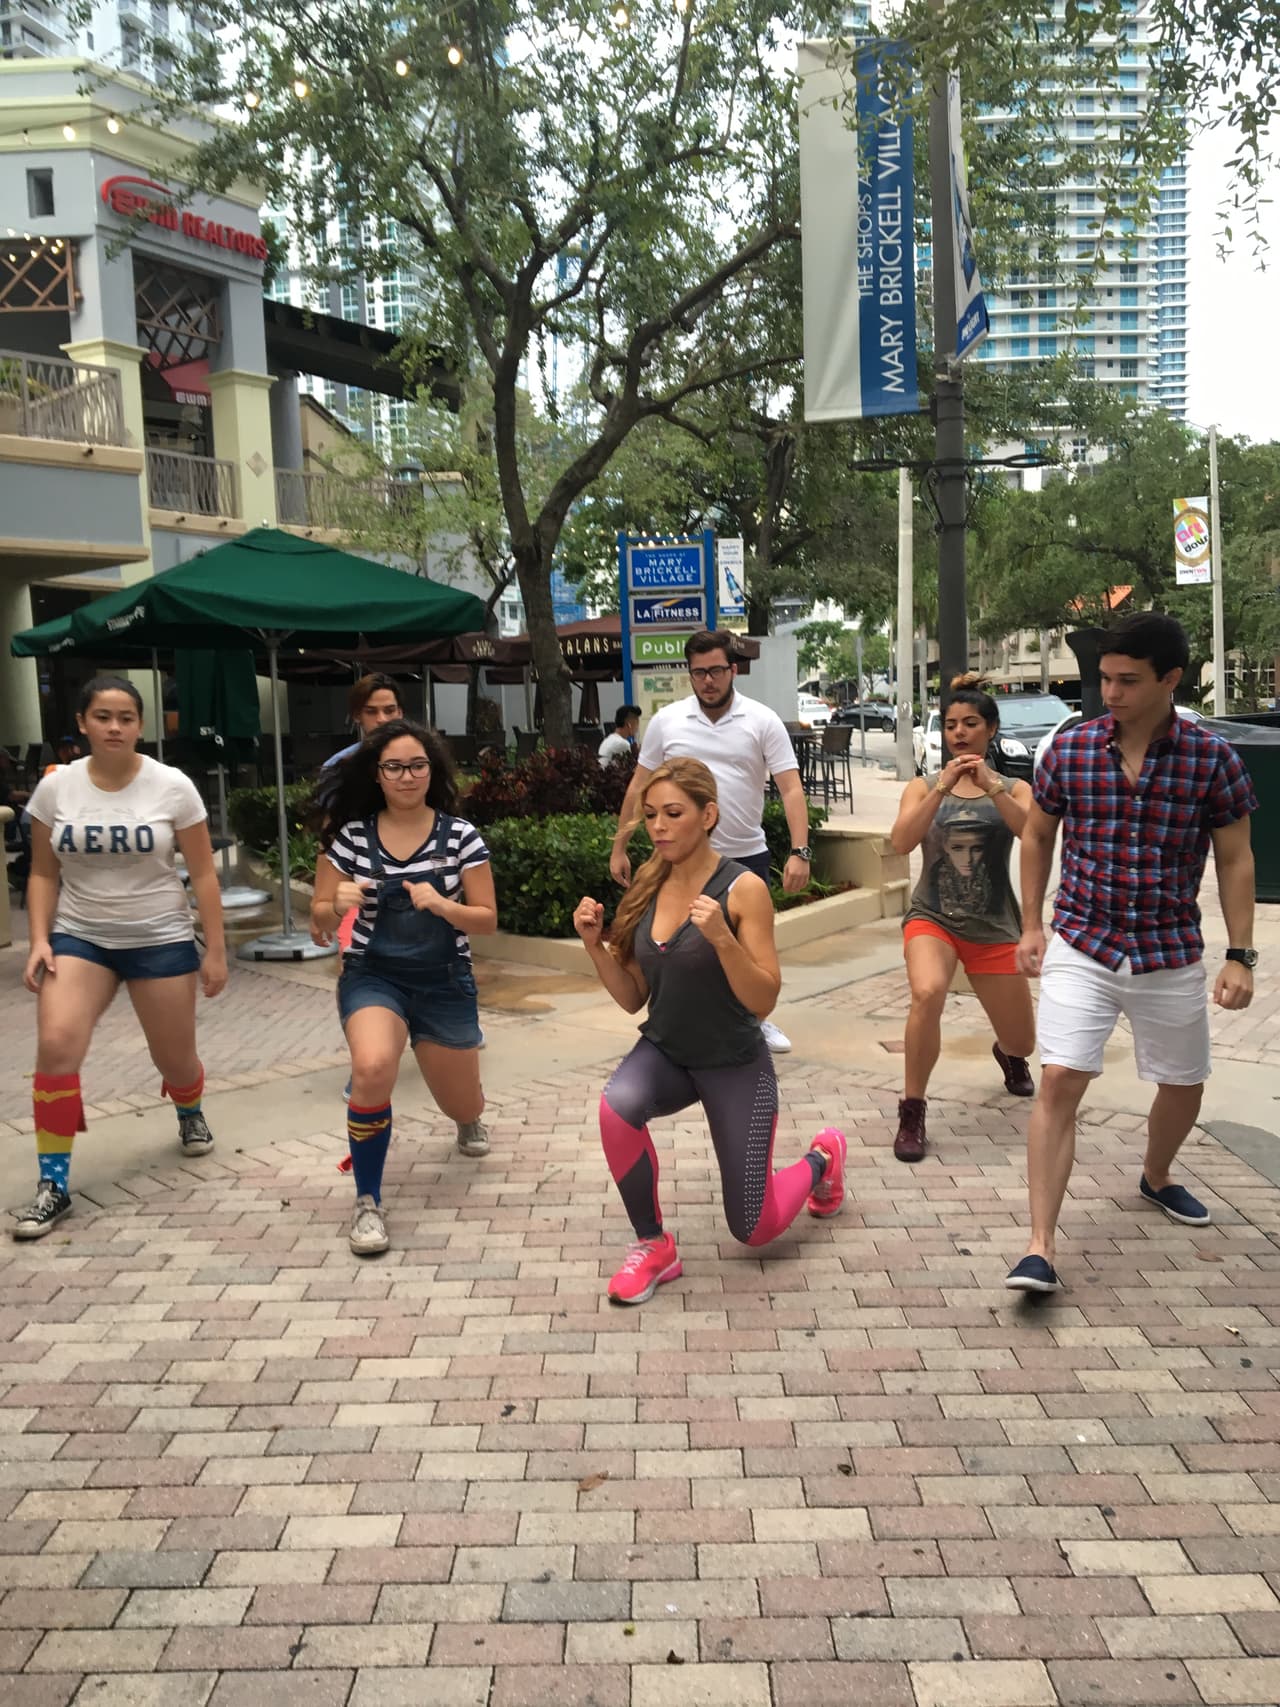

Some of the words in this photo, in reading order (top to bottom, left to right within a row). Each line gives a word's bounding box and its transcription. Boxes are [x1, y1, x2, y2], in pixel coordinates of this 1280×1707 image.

[181, 211, 268, 261] REALTORS
[858, 193, 873, 259] SHOPS
[878, 185, 903, 306] BRICKELL
[857, 263, 874, 297] THE
[880, 314, 905, 393] MARY
[635, 565, 697, 576] BRICKELL
[648, 558, 682, 567] MARY
[640, 573, 693, 584] VILLAGE
[637, 609, 651, 619] LA
[654, 607, 699, 619] FITNESS
[642, 641, 686, 655] Publi
[58, 824, 155, 854] AERO
